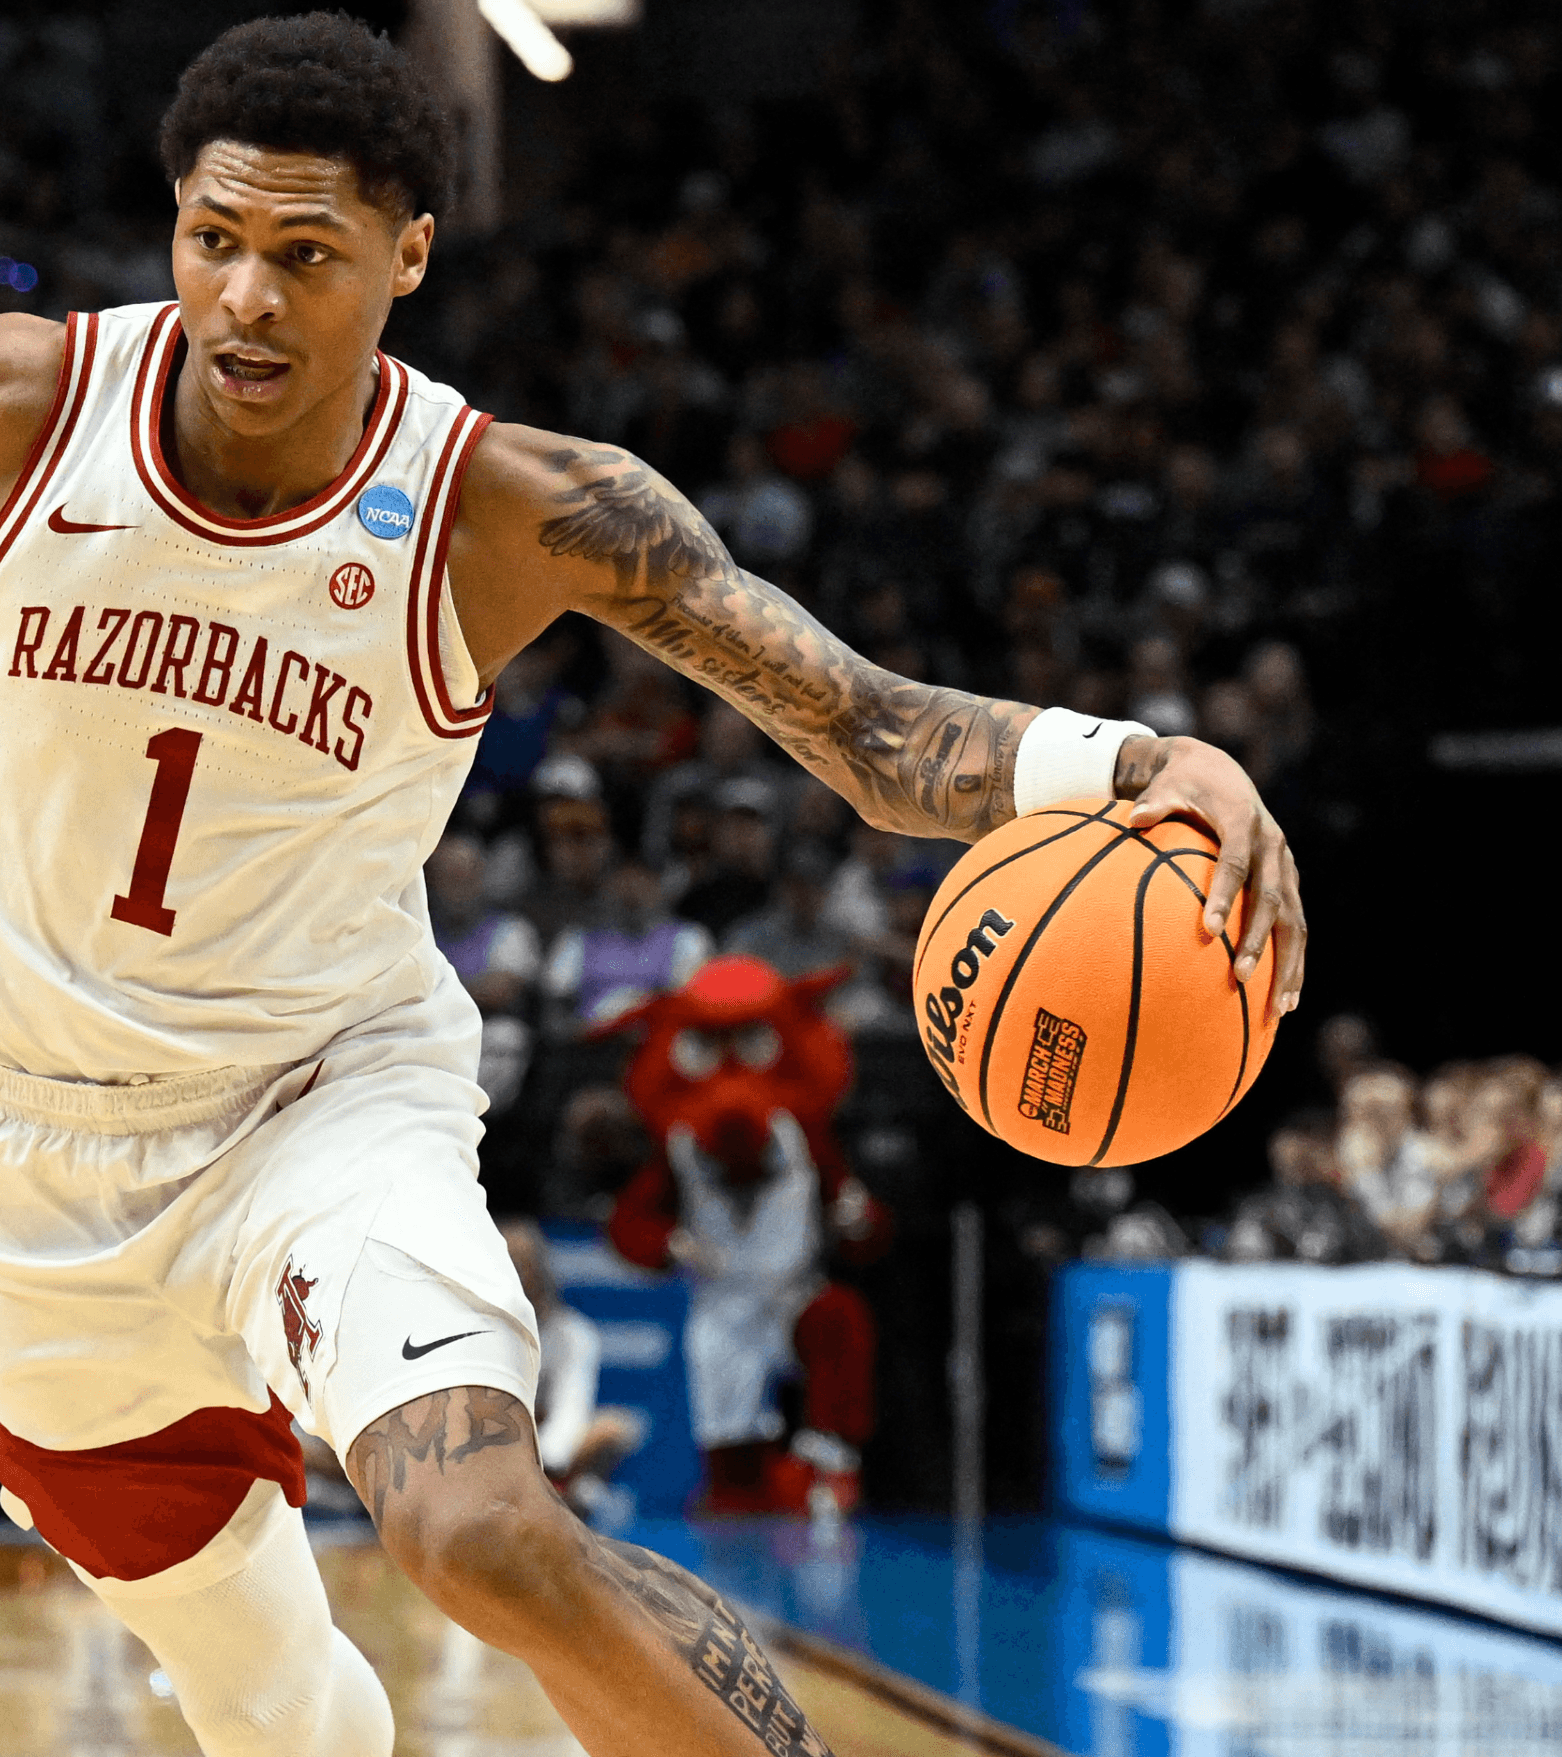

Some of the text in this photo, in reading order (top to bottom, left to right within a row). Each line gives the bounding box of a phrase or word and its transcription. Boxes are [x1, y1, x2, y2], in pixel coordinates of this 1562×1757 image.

[365, 506, 410, 529] NCAA
[333, 566, 372, 606] SEC
[8, 605, 373, 772] RAZORBACKS
[110, 727, 204, 937] 1
[958, 1001, 977, 1065] EVO NXT
[1043, 1021, 1080, 1107] MADNESS
[1023, 1044, 1053, 1107] MARCH
